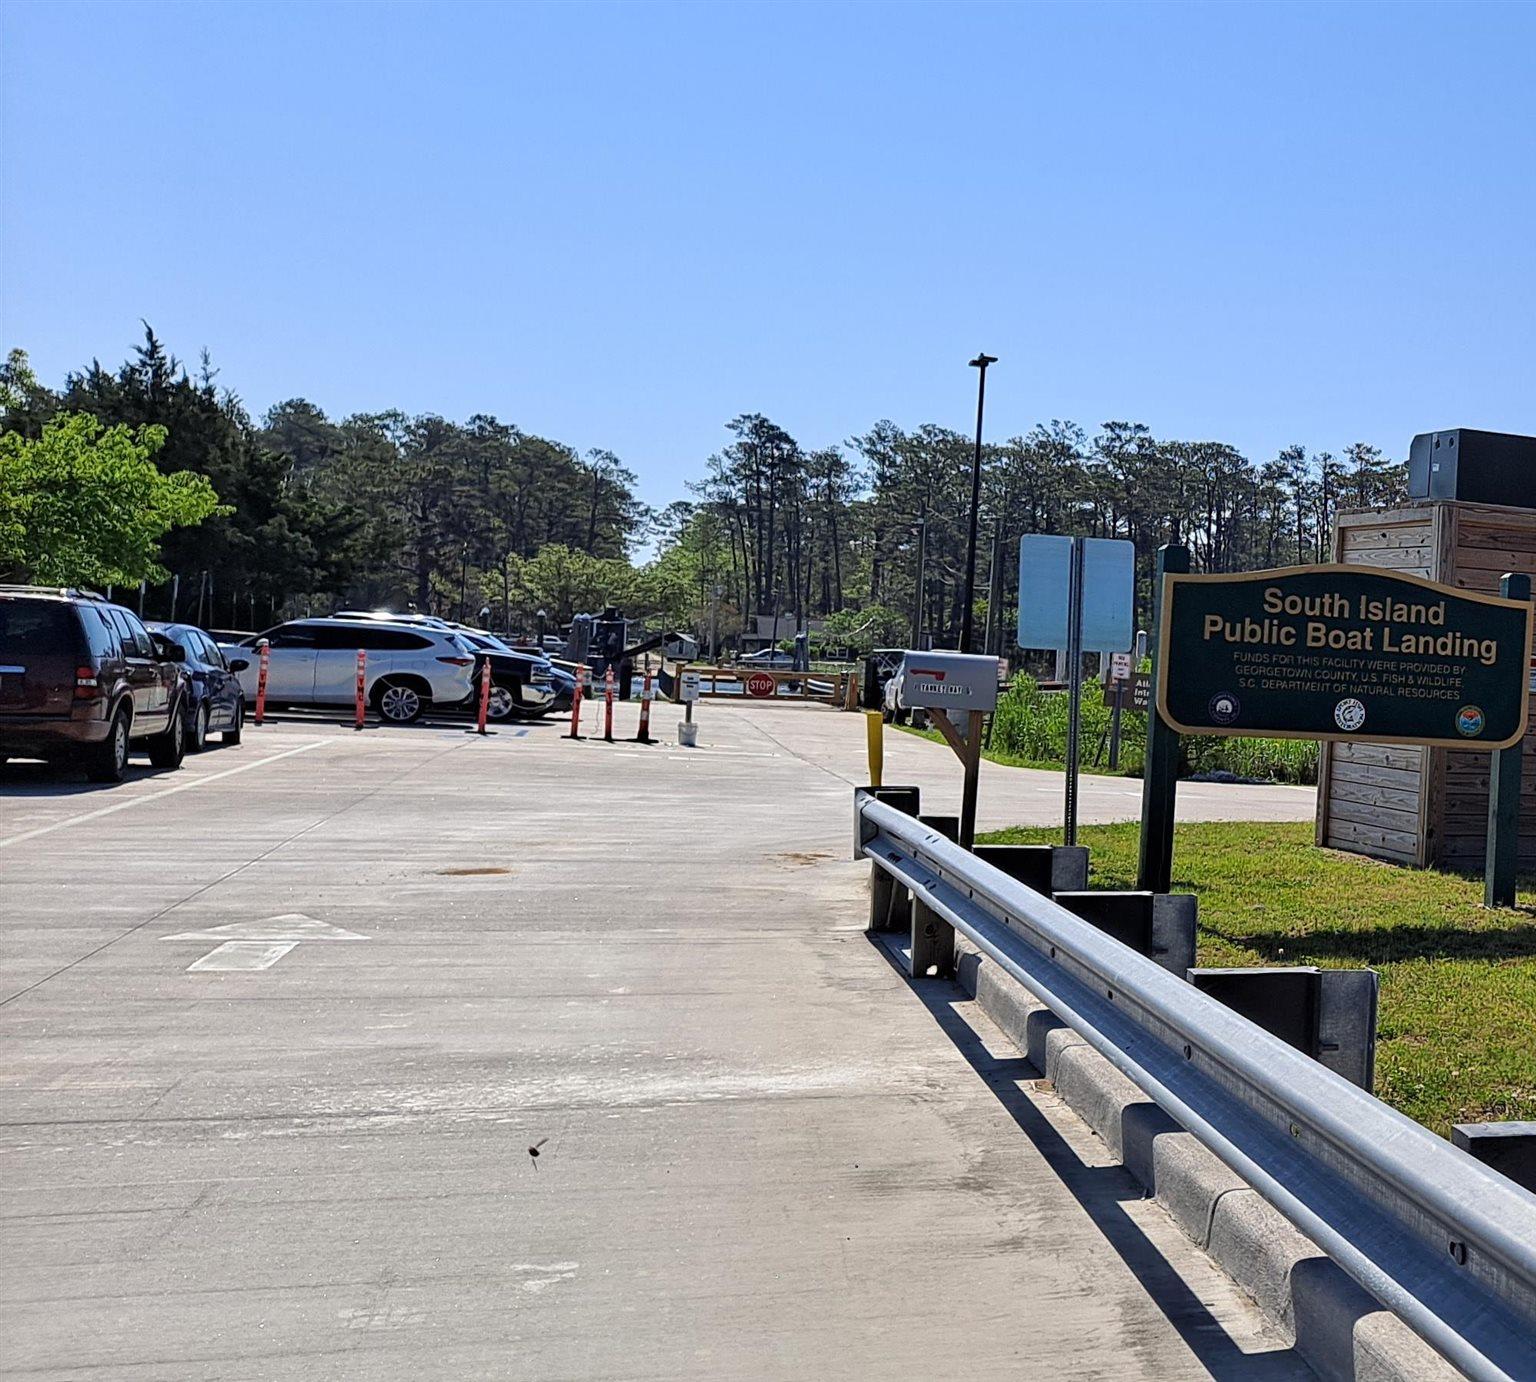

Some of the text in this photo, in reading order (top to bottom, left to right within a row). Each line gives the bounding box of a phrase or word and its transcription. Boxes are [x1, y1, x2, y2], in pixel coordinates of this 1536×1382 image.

[1263, 587, 1446, 626] South Island
[1203, 614, 1498, 665] Public Boat Landing
[1233, 651, 1466, 675] FUNDS FOR THIS FACILITY WERE PROVIDED BY
[749, 680, 773, 690] STOP
[1235, 665, 1312, 679] GEORGETOWN
[1314, 670, 1358, 682] COUNTY,
[1383, 673, 1406, 685] FISH
[1407, 675, 1414, 685] &
[1261, 679, 1330, 692] DEPARTMENT
[1332, 683, 1347, 693] OF
[1350, 684, 1395, 696] NATURAL
[1397, 687, 1460, 700] RESOURCES
